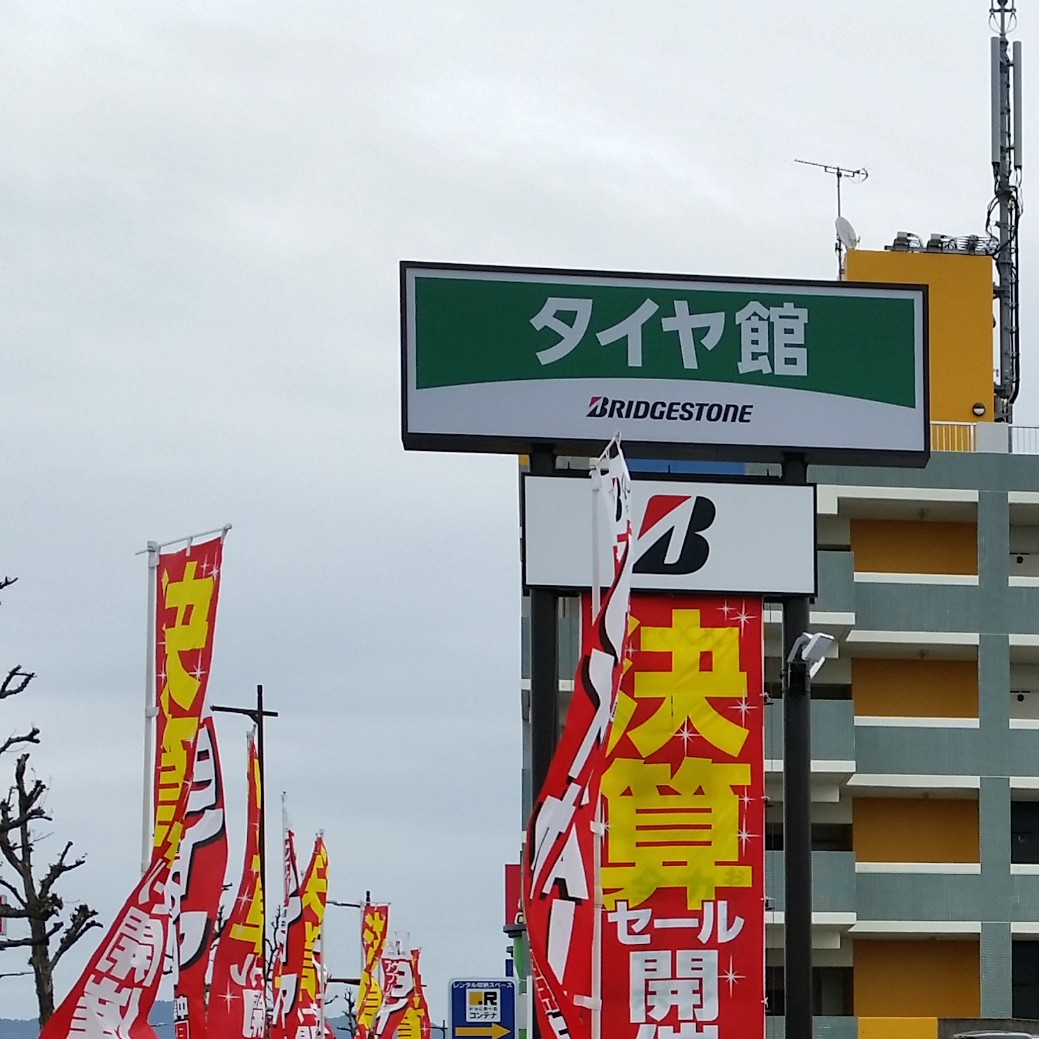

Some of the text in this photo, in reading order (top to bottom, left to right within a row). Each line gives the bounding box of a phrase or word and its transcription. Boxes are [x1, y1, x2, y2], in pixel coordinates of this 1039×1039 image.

[529, 297, 809, 377] タイヤ館
[586, 396, 754, 424] BRIDGESTONE
[599, 608, 753, 911] 決算
[607, 900, 745, 945] セール
